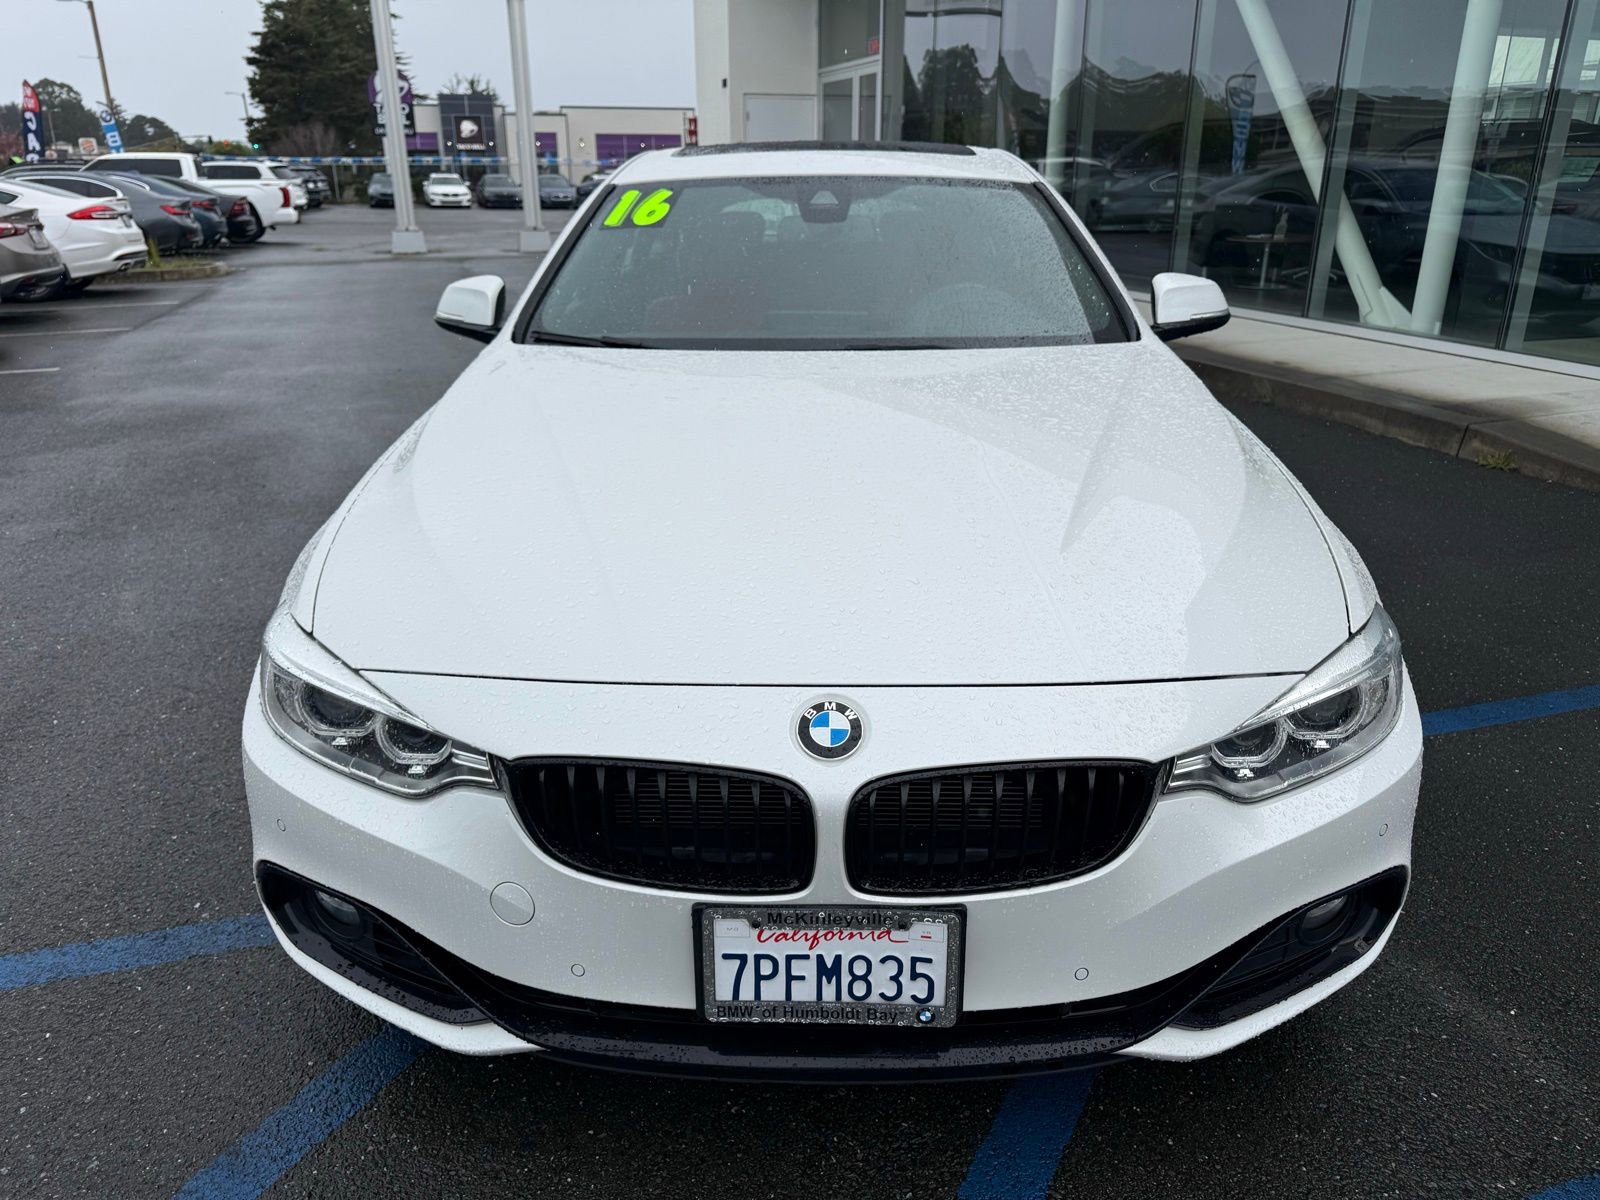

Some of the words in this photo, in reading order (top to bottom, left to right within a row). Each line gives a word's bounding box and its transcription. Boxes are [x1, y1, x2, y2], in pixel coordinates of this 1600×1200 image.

[603, 189, 673, 227] 16
[803, 701, 858, 720] BMW
[767, 912, 893, 927] McKinleyville
[757, 929, 909, 950] California
[721, 953, 935, 1005] 7PFM835
[716, 1005, 754, 1018] BMW
[762, 1006, 780, 1018] of
[783, 1006, 861, 1020] Humboldt
[867, 1008, 898, 1024] Bay
